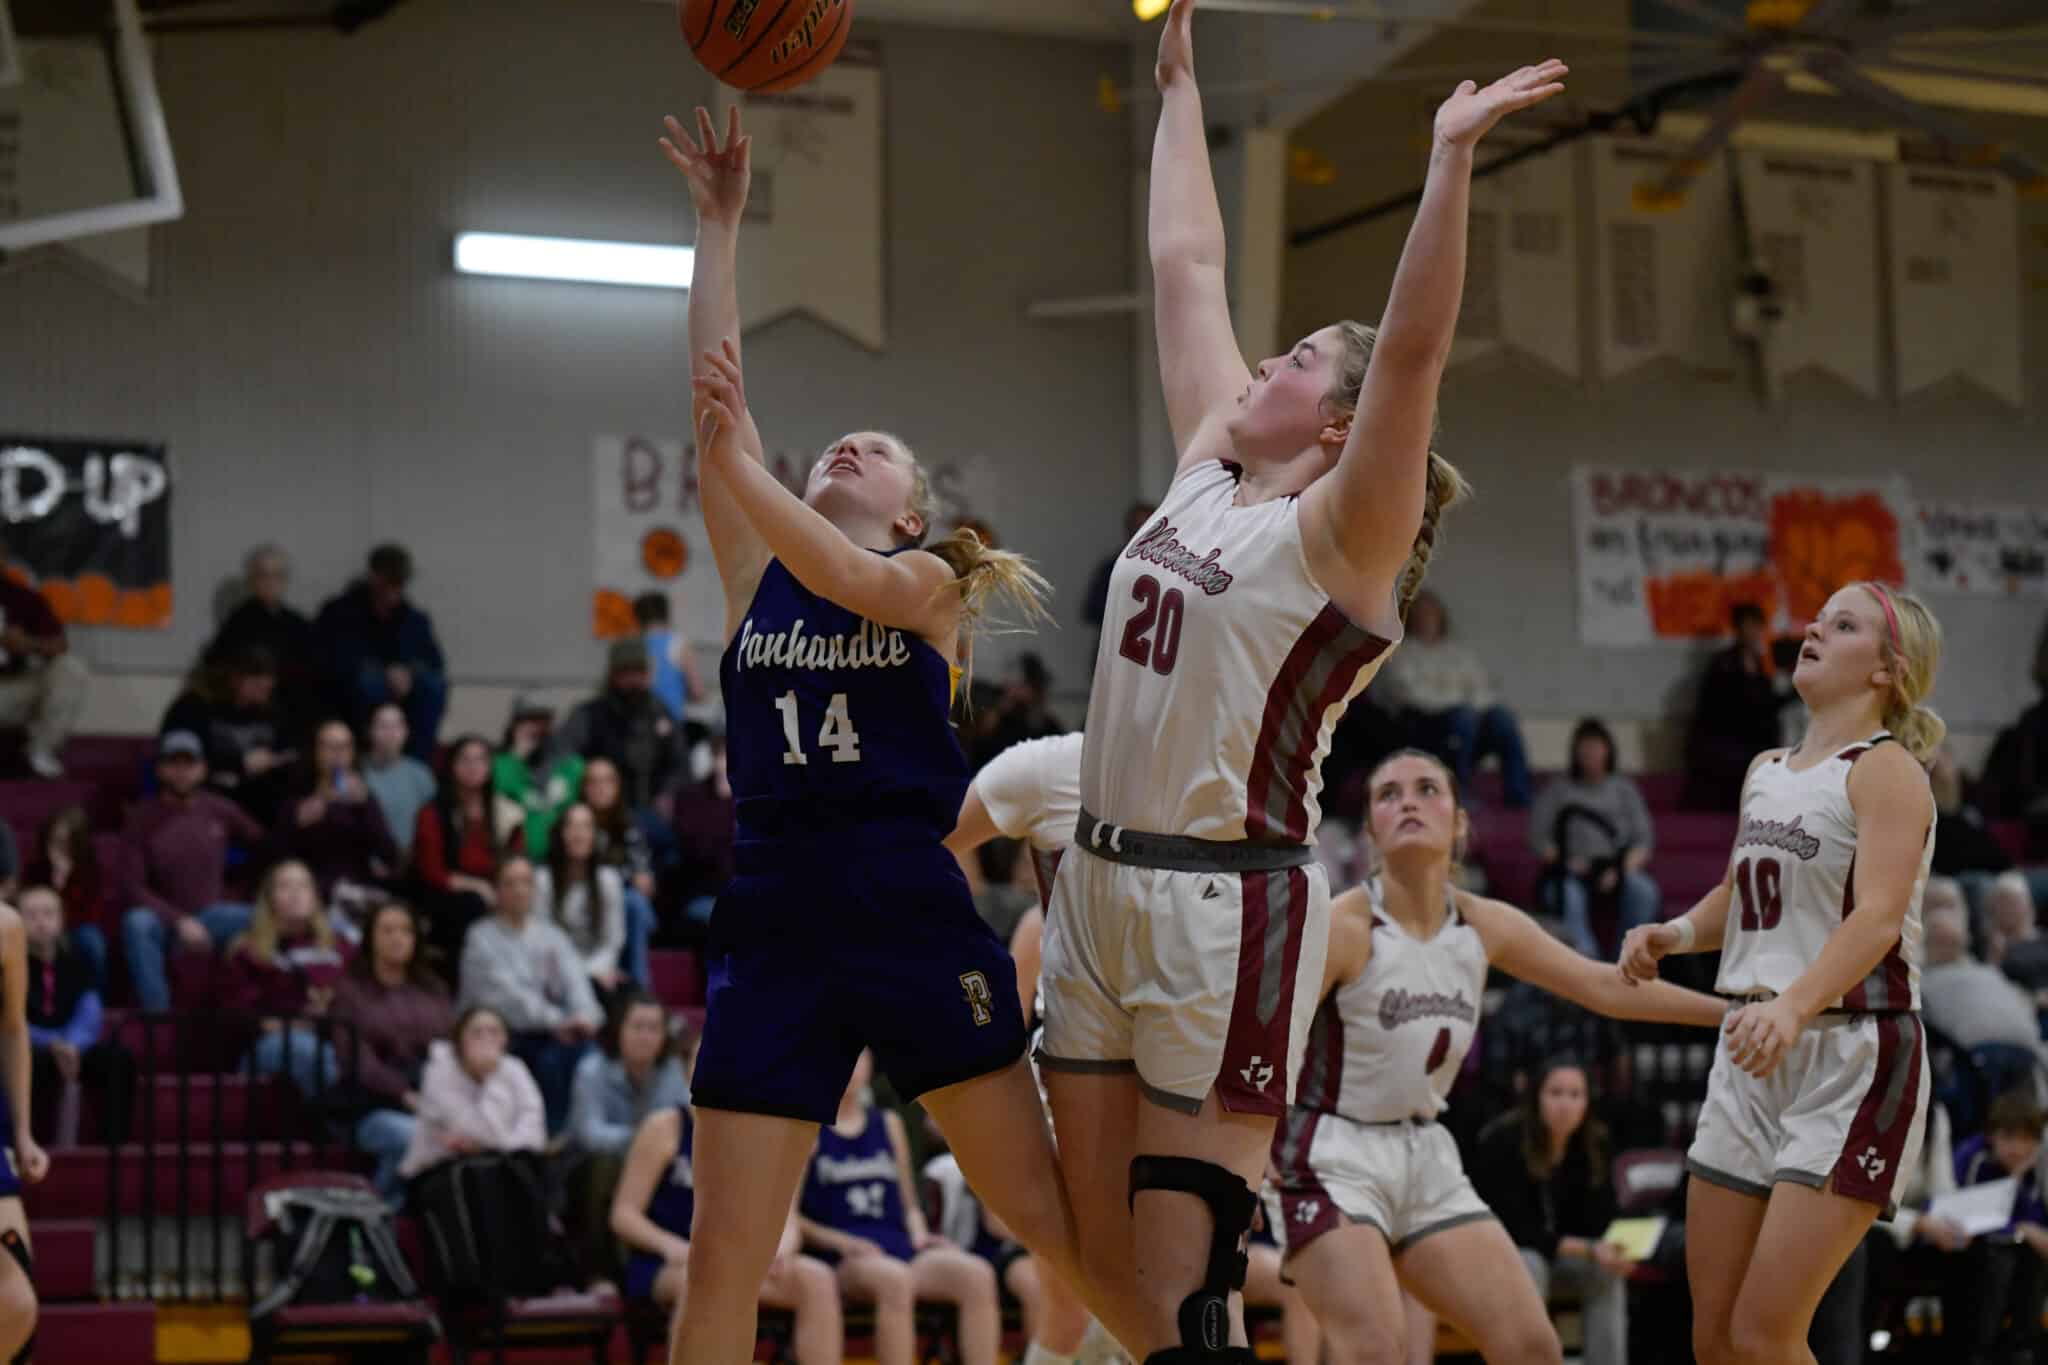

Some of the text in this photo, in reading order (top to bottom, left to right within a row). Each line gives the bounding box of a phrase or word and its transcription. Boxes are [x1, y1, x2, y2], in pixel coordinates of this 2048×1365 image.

[737, 618, 910, 674] Panhandle
[1119, 574, 1185, 676] 20
[775, 689, 861, 765] 14
